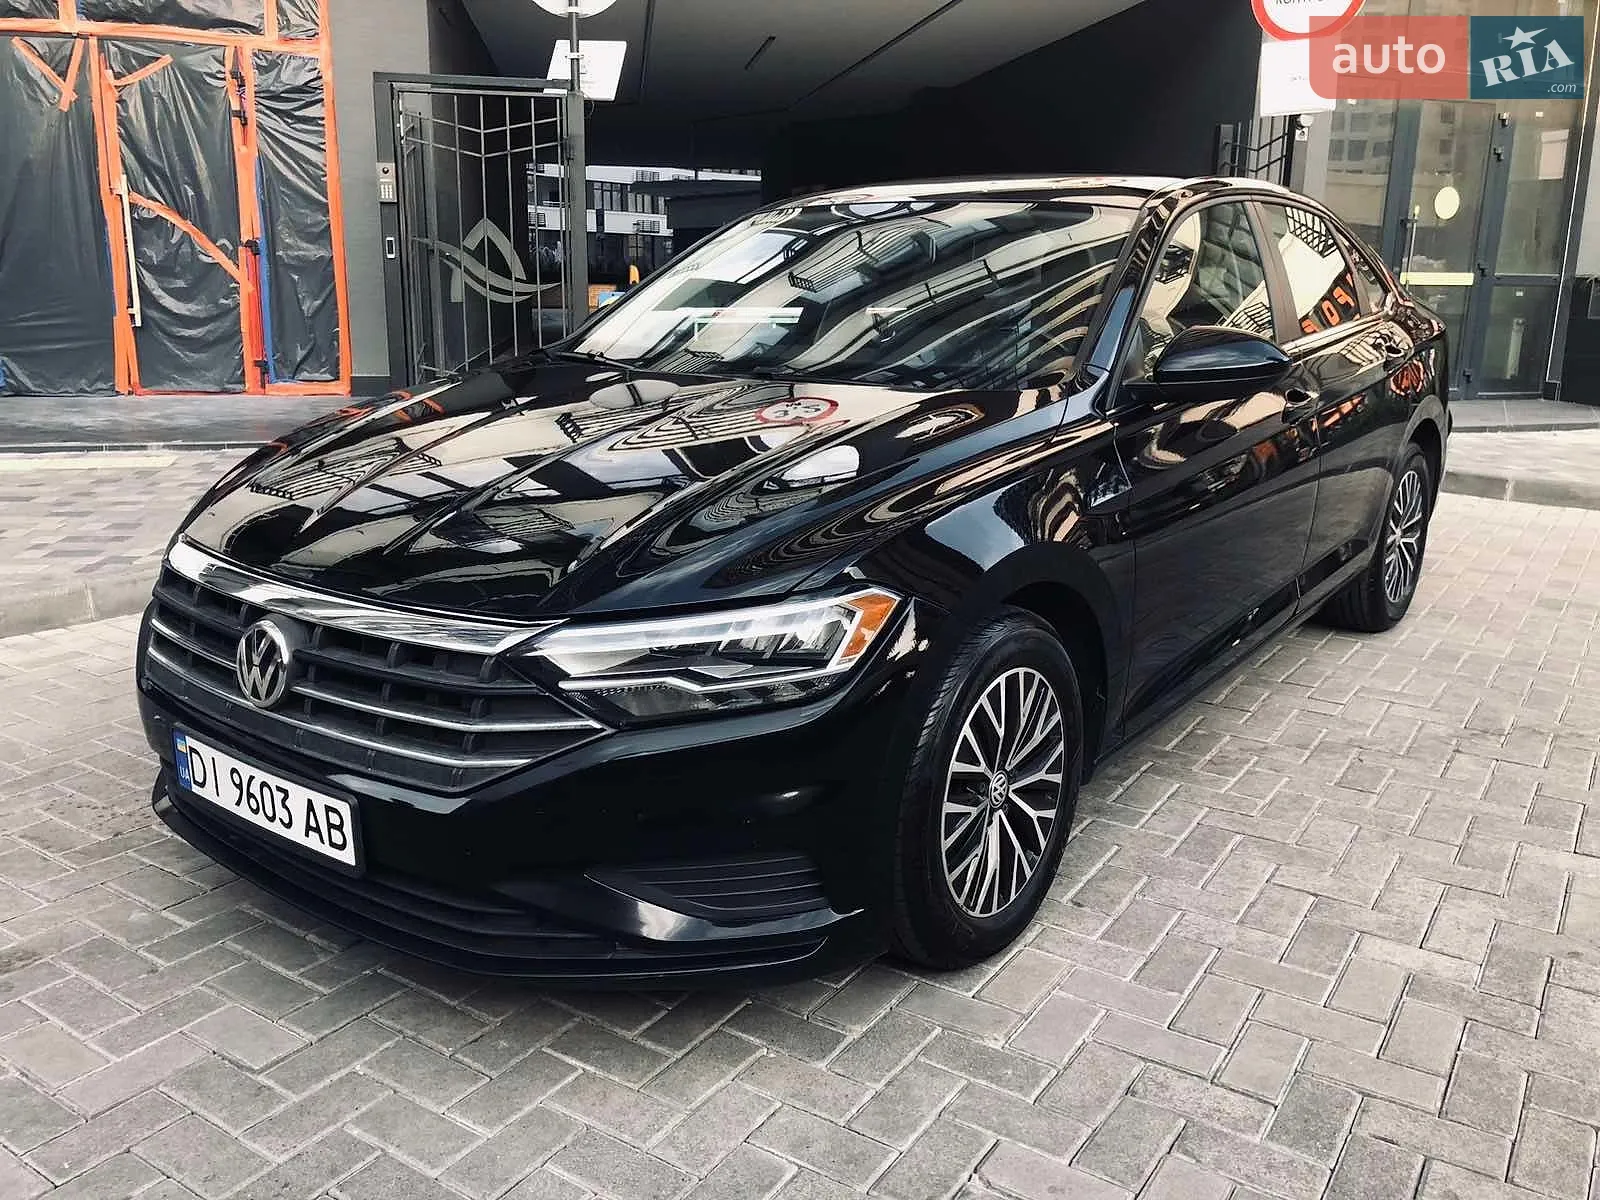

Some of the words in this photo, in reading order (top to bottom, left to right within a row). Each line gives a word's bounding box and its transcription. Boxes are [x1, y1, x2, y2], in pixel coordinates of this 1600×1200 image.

[179, 766, 190, 780] UA
[188, 746, 220, 797] DI
[230, 767, 293, 829] 9603
[304, 798, 347, 851] AB
